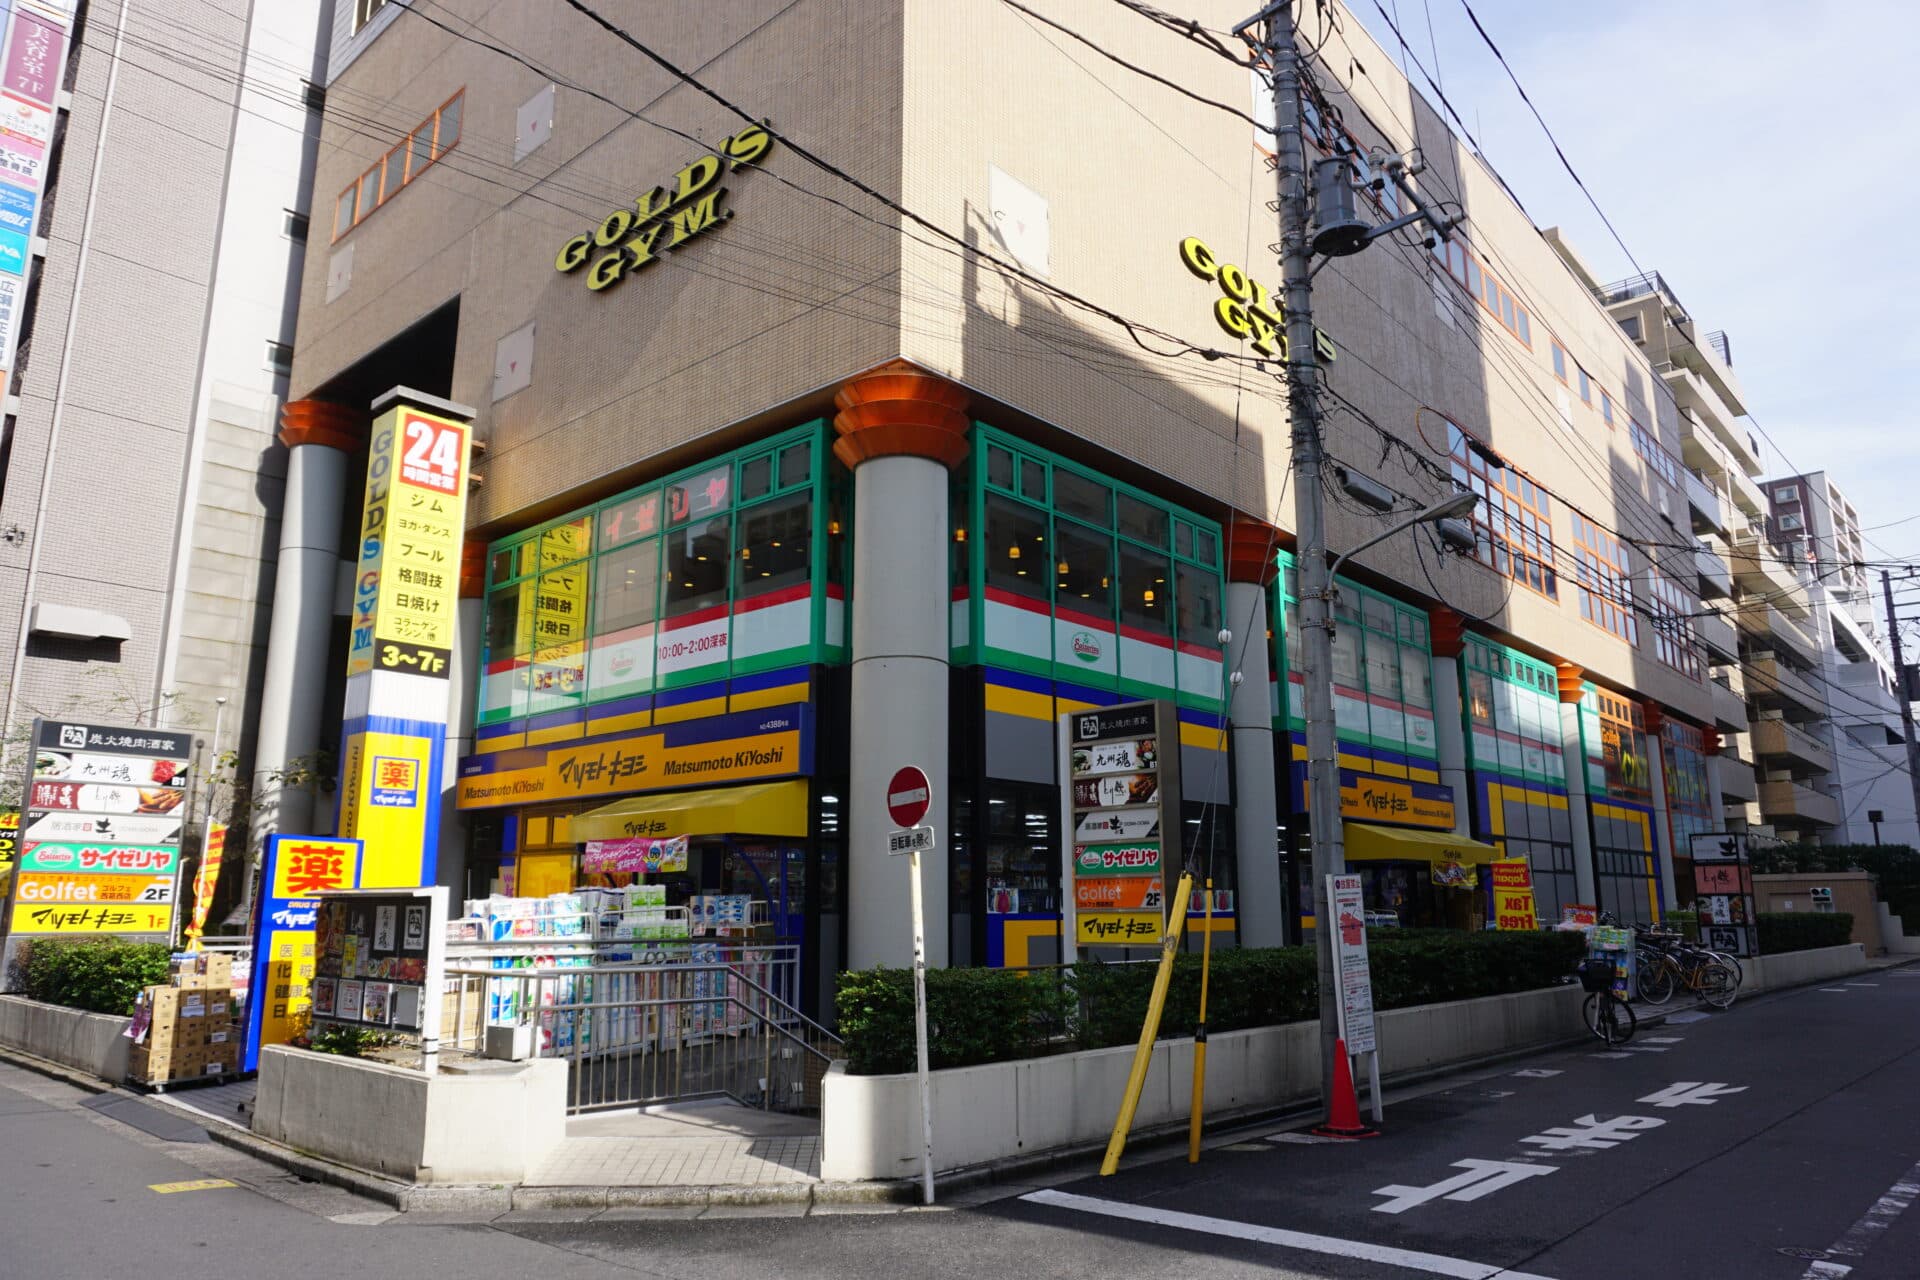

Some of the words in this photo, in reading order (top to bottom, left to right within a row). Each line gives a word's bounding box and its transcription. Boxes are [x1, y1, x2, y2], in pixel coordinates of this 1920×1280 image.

[18, 75, 46, 94] 7F
[555, 118, 774, 273] GOLD'S
[1213, 296, 1289, 364] GY
[403, 420, 459, 476] 24
[362, 429, 393, 560] GOLD'S
[410, 494, 444, 513] ジム
[606, 477, 728, 544] イゼリヤ
[398, 567, 443, 589] 格闘技
[352, 571, 378, 651] GYM
[396, 593, 440, 613] 日焼け
[663, 755, 734, 776] Matsumoto
[733, 746, 784, 768] KiYoshi
[1096, 750, 1131, 768] 九州魂
[83, 763, 131, 782] 九州魂
[382, 761, 411, 788] 薬
[559, 751, 648, 790] マツモトキヨシ
[464, 783, 512, 800] Matsumoto
[512, 778, 544, 795] KiYoshi
[80, 849, 171, 869] サイゼリヤ
[286, 844, 345, 893] 薬
[1103, 849, 1158, 867] サイゼリヤ
[19, 881, 98, 900] Golfet
[144, 888, 171, 900] 2F
[1077, 885, 1122, 901] Golfet
[1146, 892, 1161, 907] 2F
[31, 907, 137, 929] マツモトキヨシ
[147, 914, 166, 928] 1F
[271, 909, 318, 929] マツモト
[1083, 917, 1156, 938] マツモトキヨシ
[1370, 1081, 1750, 1214] 止まれ
